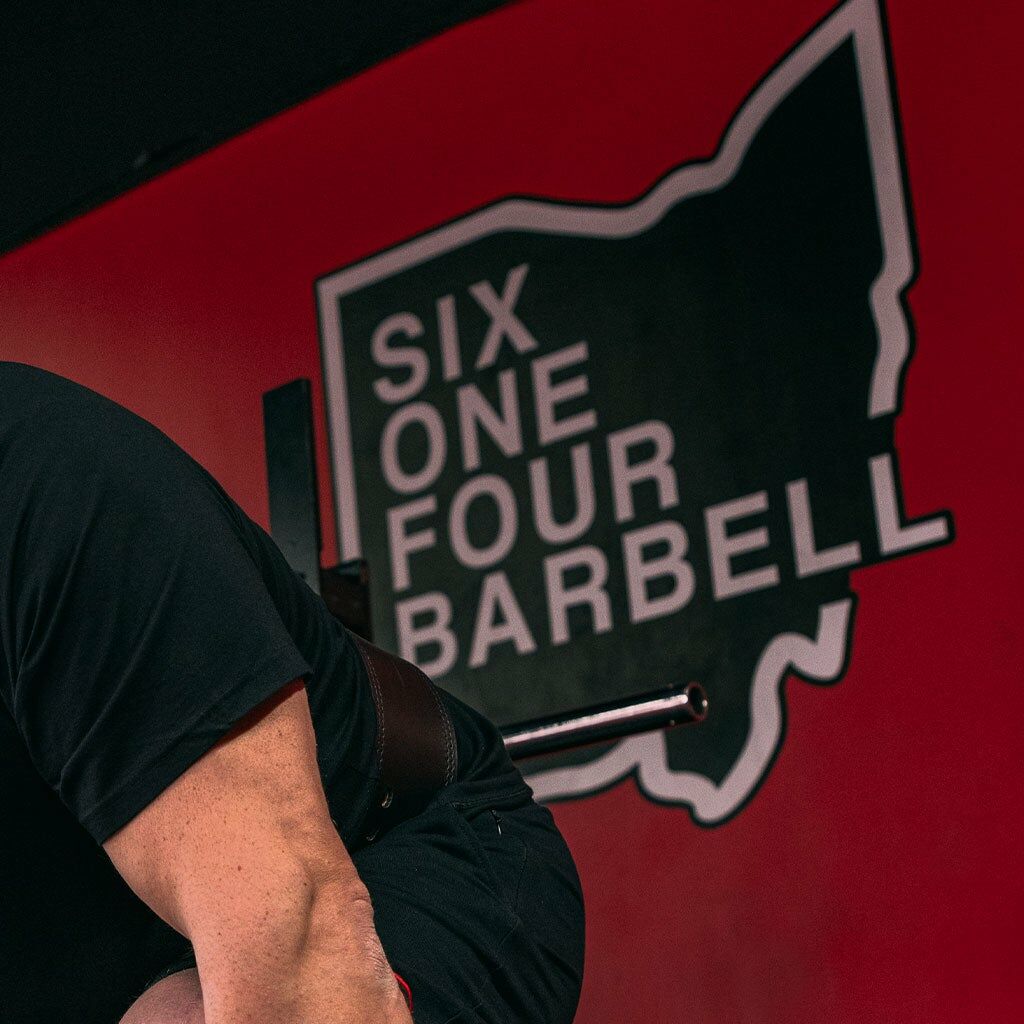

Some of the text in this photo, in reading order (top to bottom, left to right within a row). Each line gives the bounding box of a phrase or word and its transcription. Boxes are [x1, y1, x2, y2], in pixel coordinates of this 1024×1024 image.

[369, 262, 539, 405] SIX
[380, 340, 598, 496] ONE
[386, 418, 680, 592] FOUR
[394, 452, 950, 680] BARBELL
